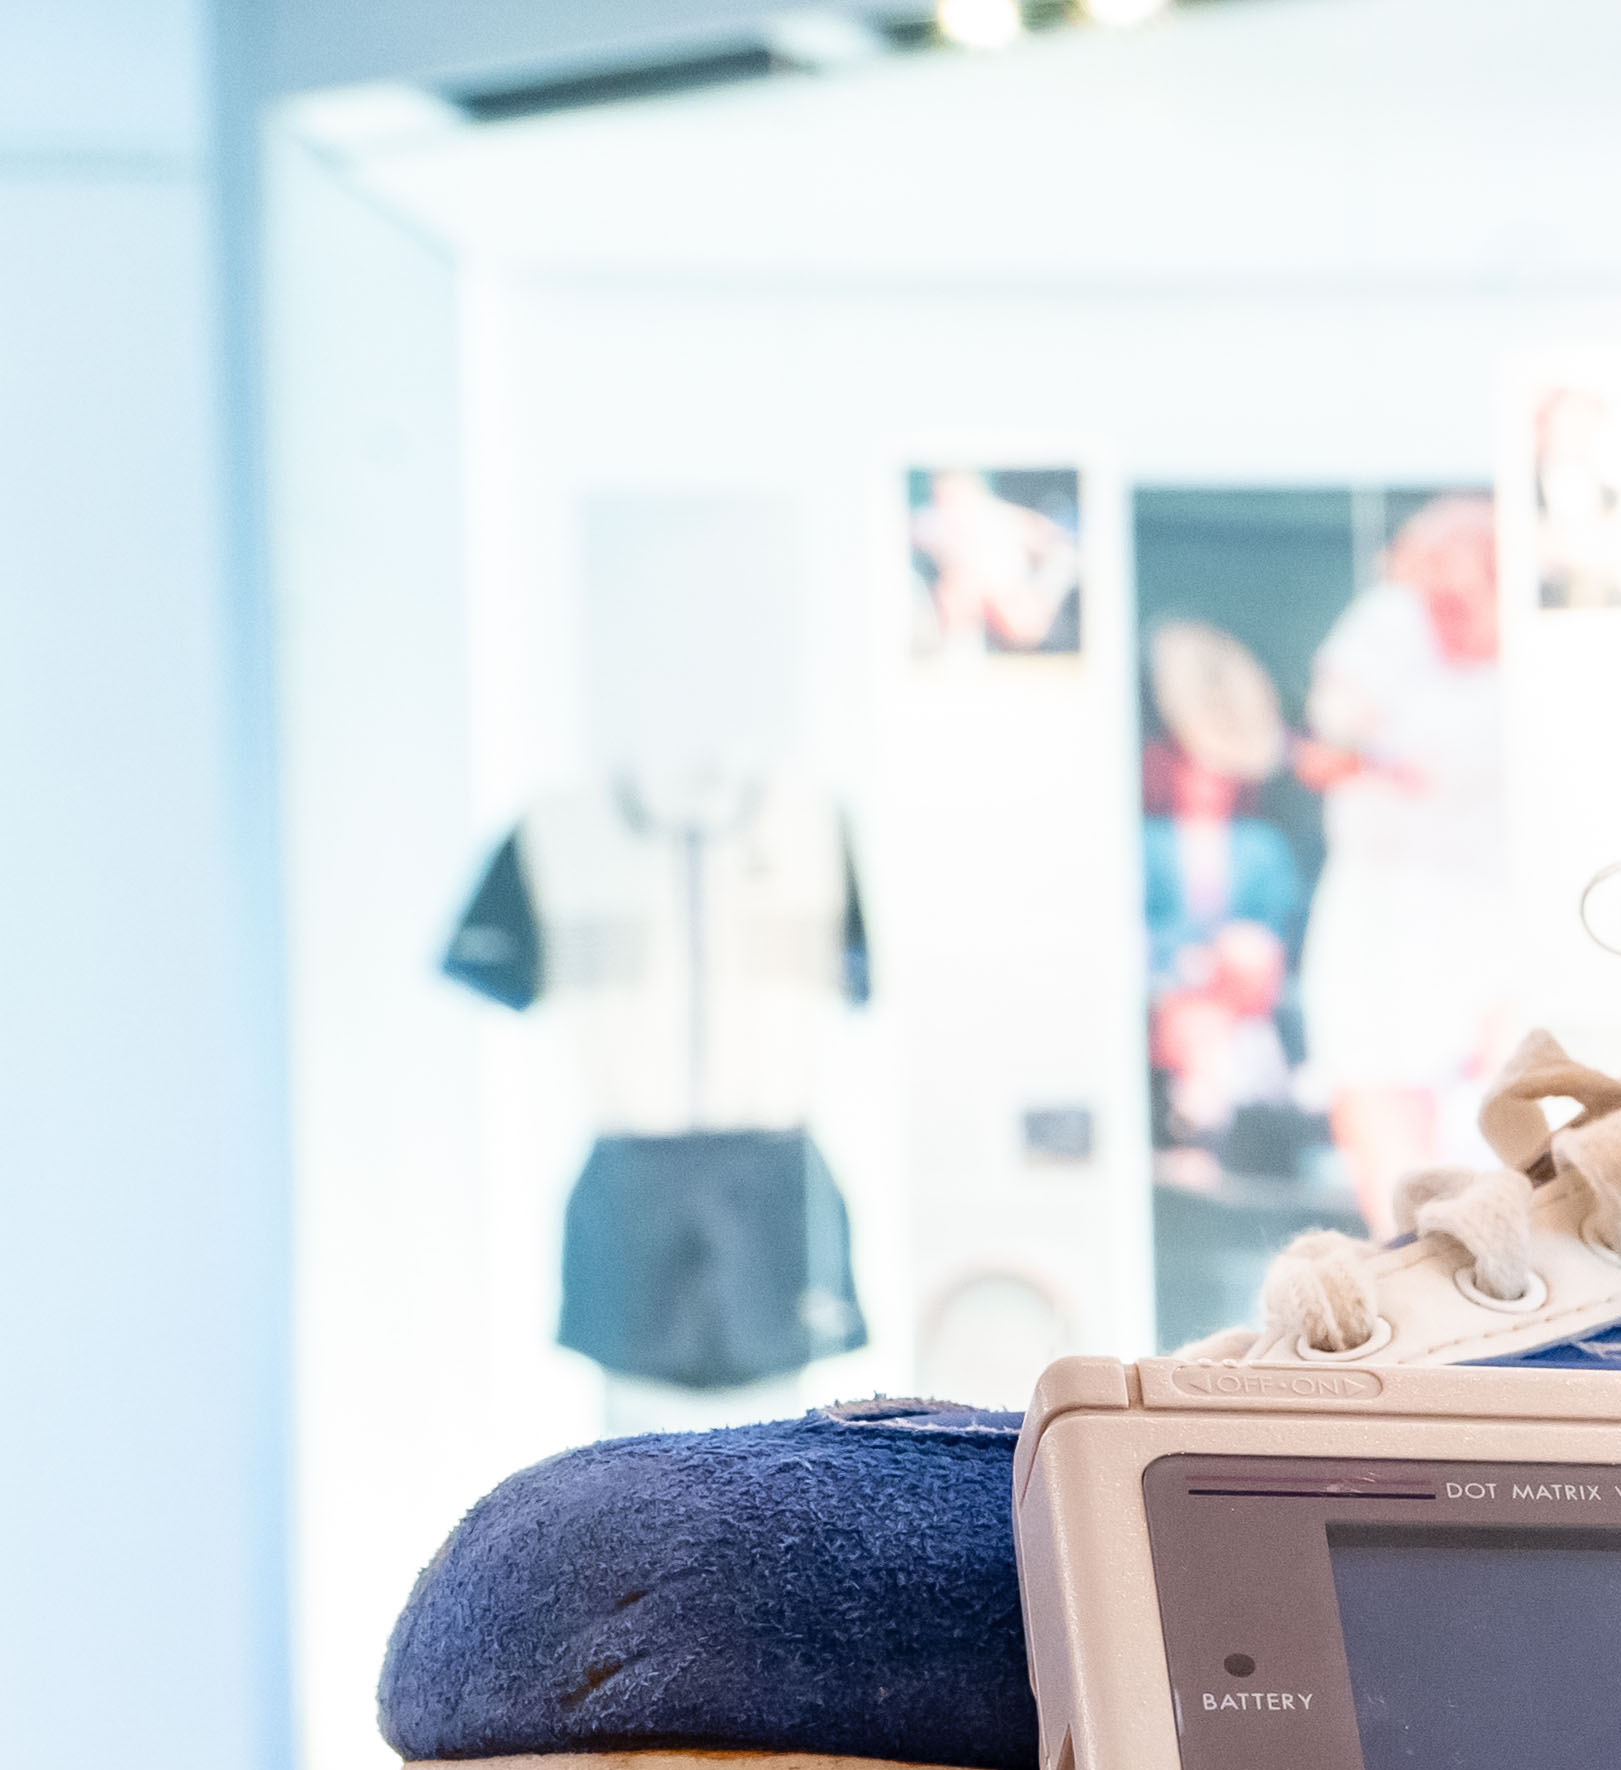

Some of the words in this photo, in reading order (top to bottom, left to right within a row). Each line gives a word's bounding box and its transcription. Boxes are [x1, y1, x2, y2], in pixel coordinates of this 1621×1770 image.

[1446, 1481, 1498, 1500] DOT
[1512, 1483, 1602, 1501] MATRIX
[1202, 1692, 1313, 1711] BATTERY
